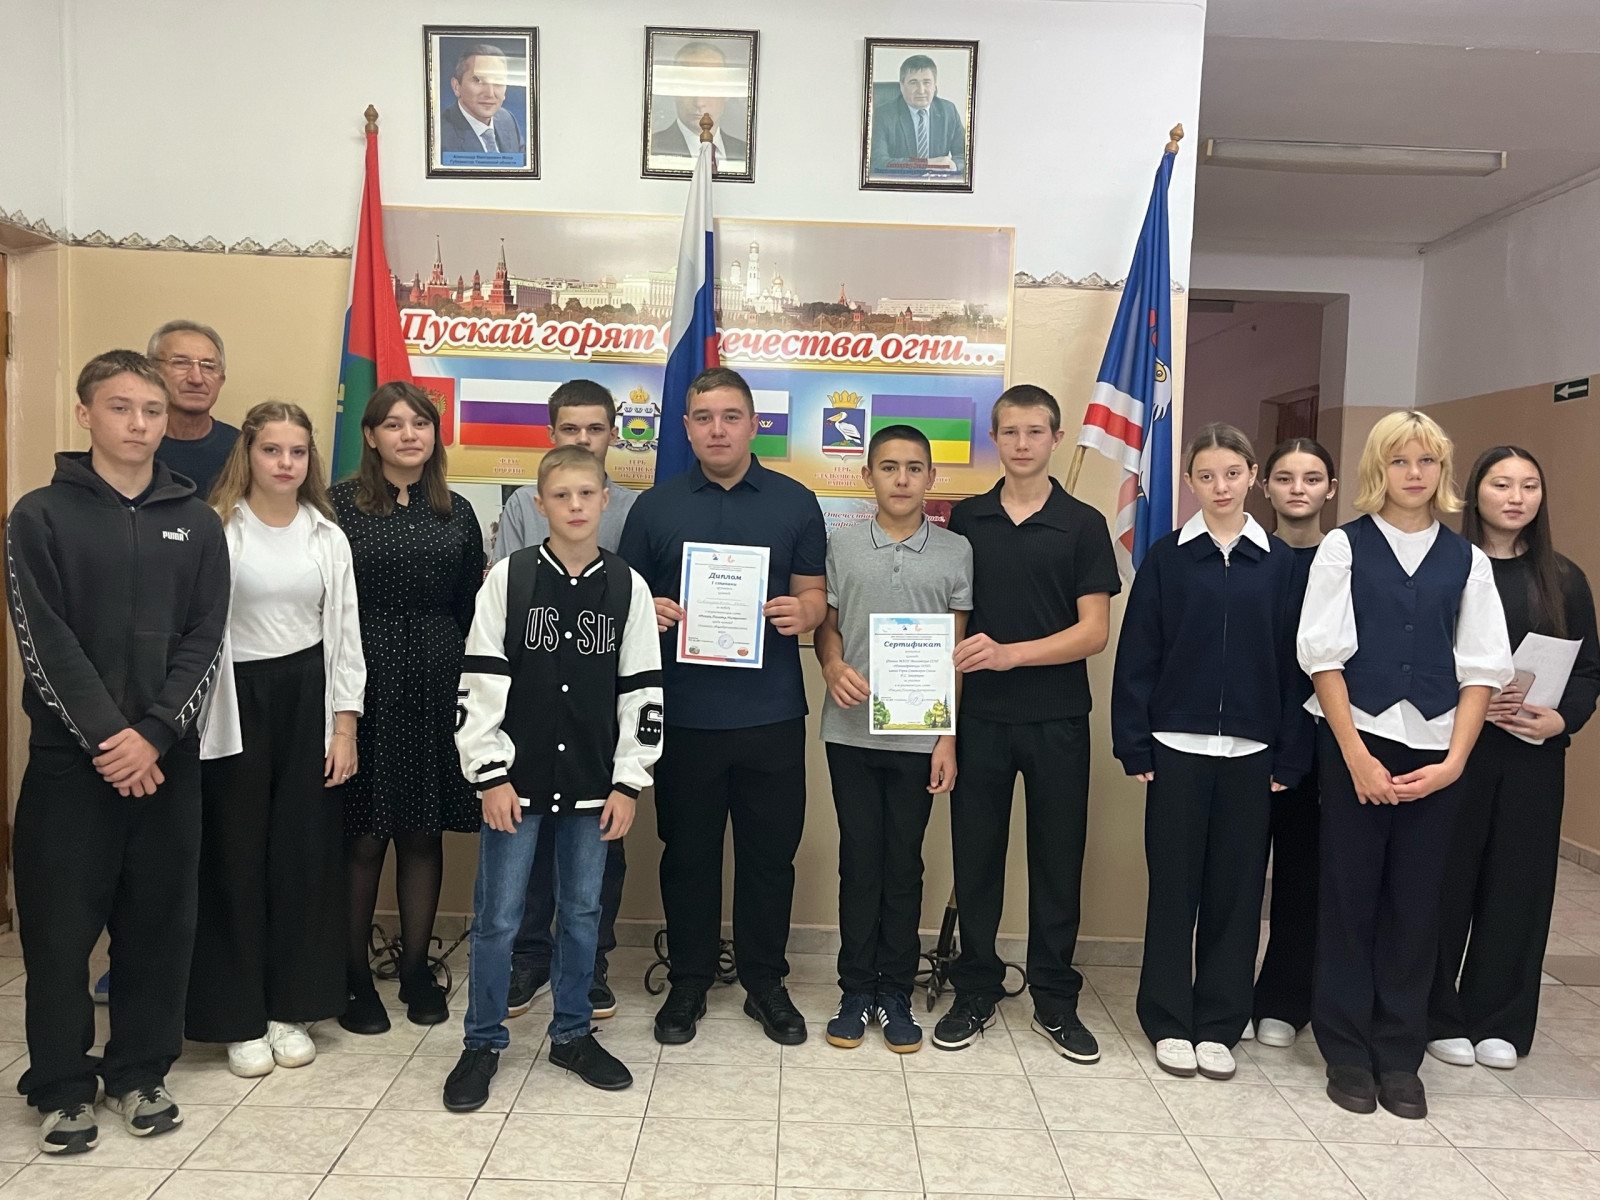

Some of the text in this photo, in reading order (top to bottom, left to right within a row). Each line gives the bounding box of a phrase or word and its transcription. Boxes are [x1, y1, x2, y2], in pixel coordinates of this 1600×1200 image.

[403, 313, 995, 362] Пускай горят ечества огни...
[162, 531, 184, 541] PUMA
[708, 572, 742, 581] Диплом
[884, 641, 942, 649] Сертификат
